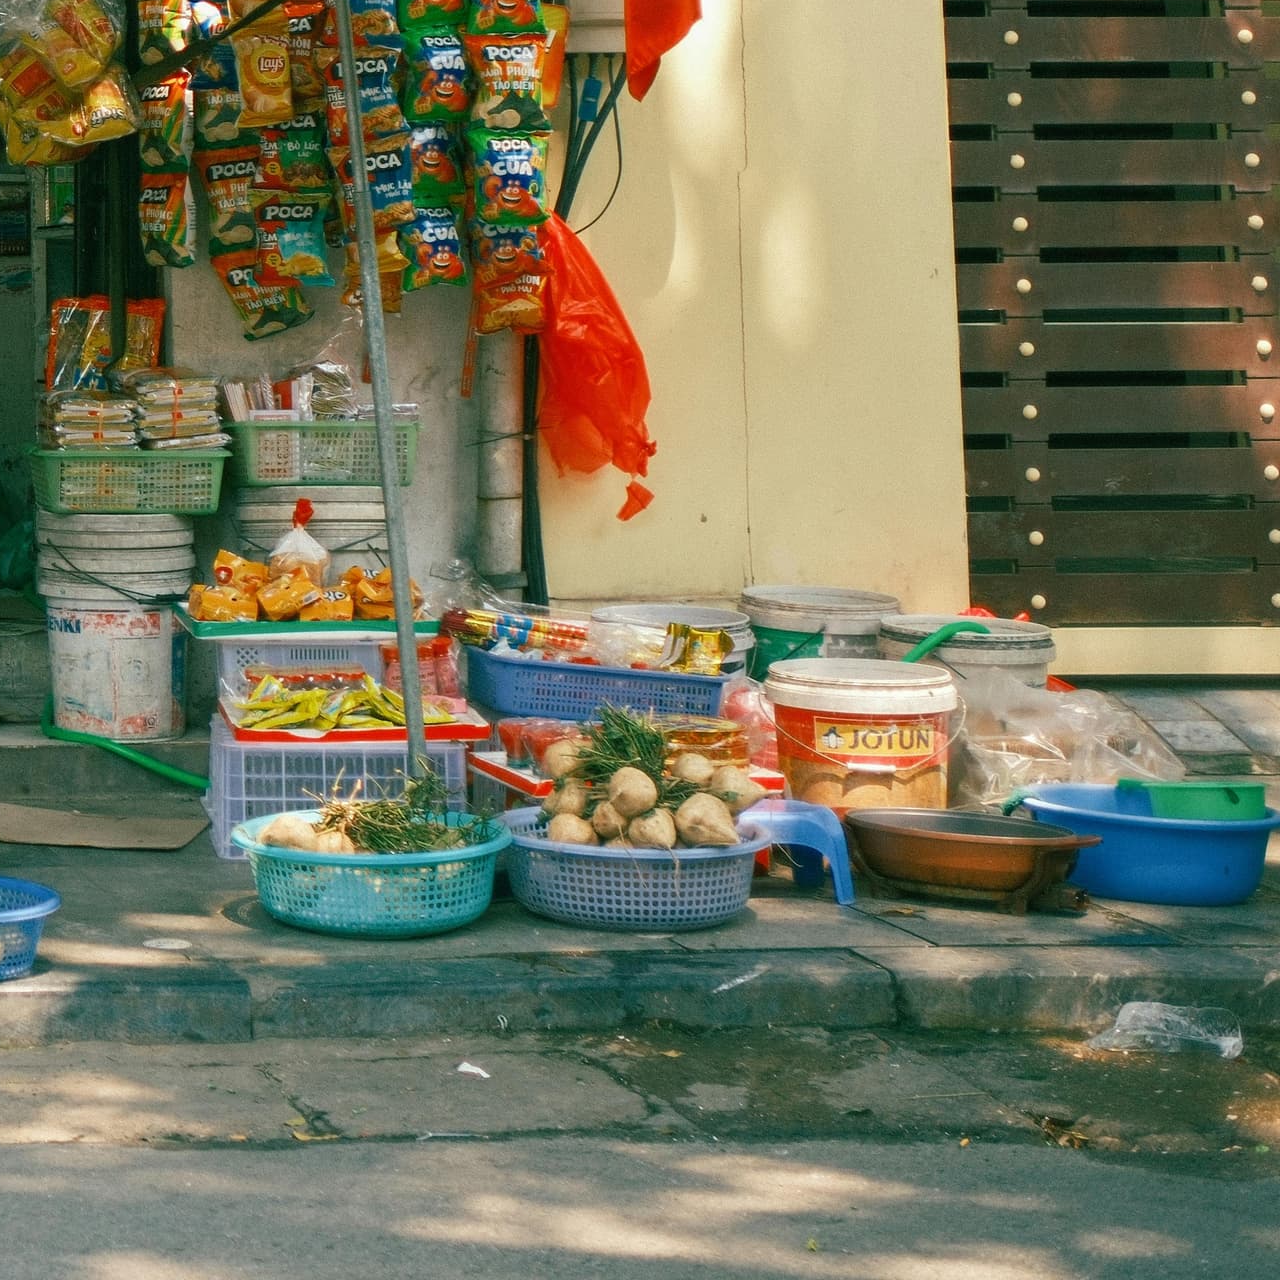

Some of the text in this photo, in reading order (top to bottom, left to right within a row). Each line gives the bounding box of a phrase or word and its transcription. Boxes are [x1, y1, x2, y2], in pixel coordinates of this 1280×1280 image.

[424, 36, 461, 46] POCA
[485, 45, 534, 60] POCA
[259, 56, 286, 72] Lay's
[430, 55, 466, 70] CUA
[142, 86, 170, 100] POCA
[287, 140, 301, 151] BÒ
[304, 140, 321, 150] LÚC
[490, 139, 531, 152] POCA
[210, 162, 256, 180] POCA
[493, 162, 533, 176] CUA
[264, 205, 314, 220] POCA
[422, 226, 458, 242] CUA
[848, 729, 929, 750] JOTUN
